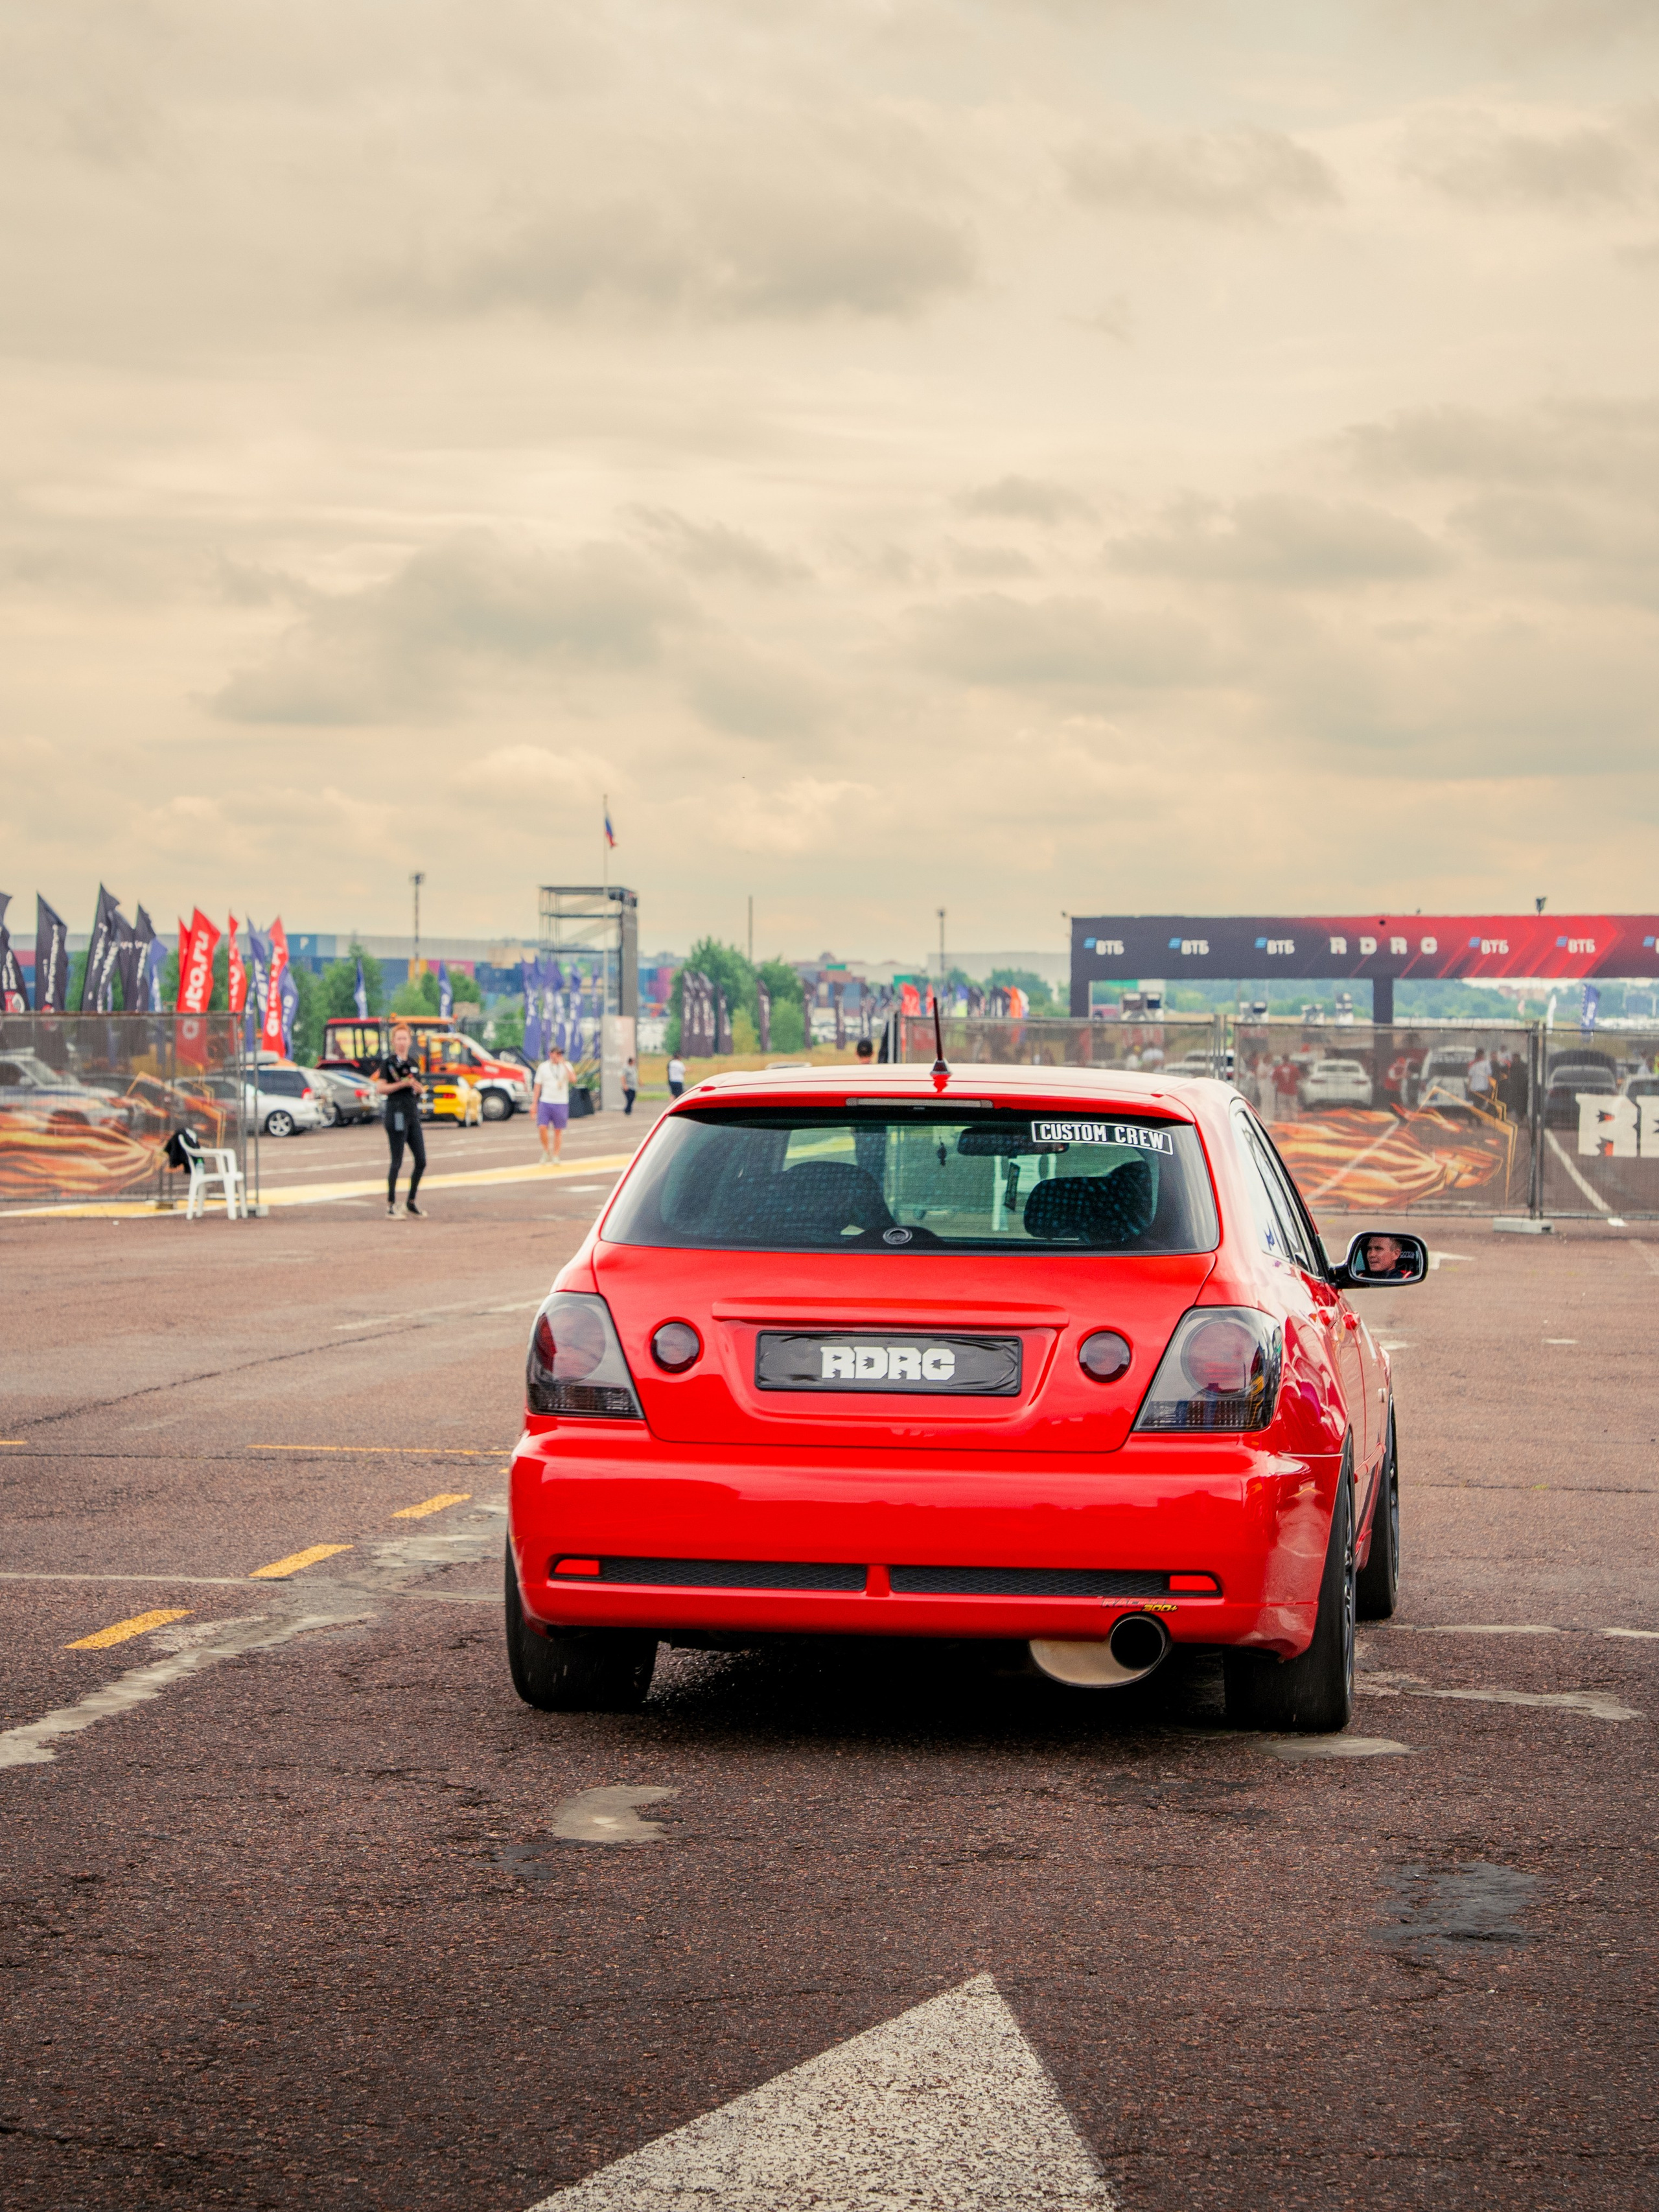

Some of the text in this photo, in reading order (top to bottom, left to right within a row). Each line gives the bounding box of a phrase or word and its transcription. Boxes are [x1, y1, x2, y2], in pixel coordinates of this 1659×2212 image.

[1039, 1123, 1165, 1150] CUSTOM CREW
[820, 1346, 956, 1380] RDRC
